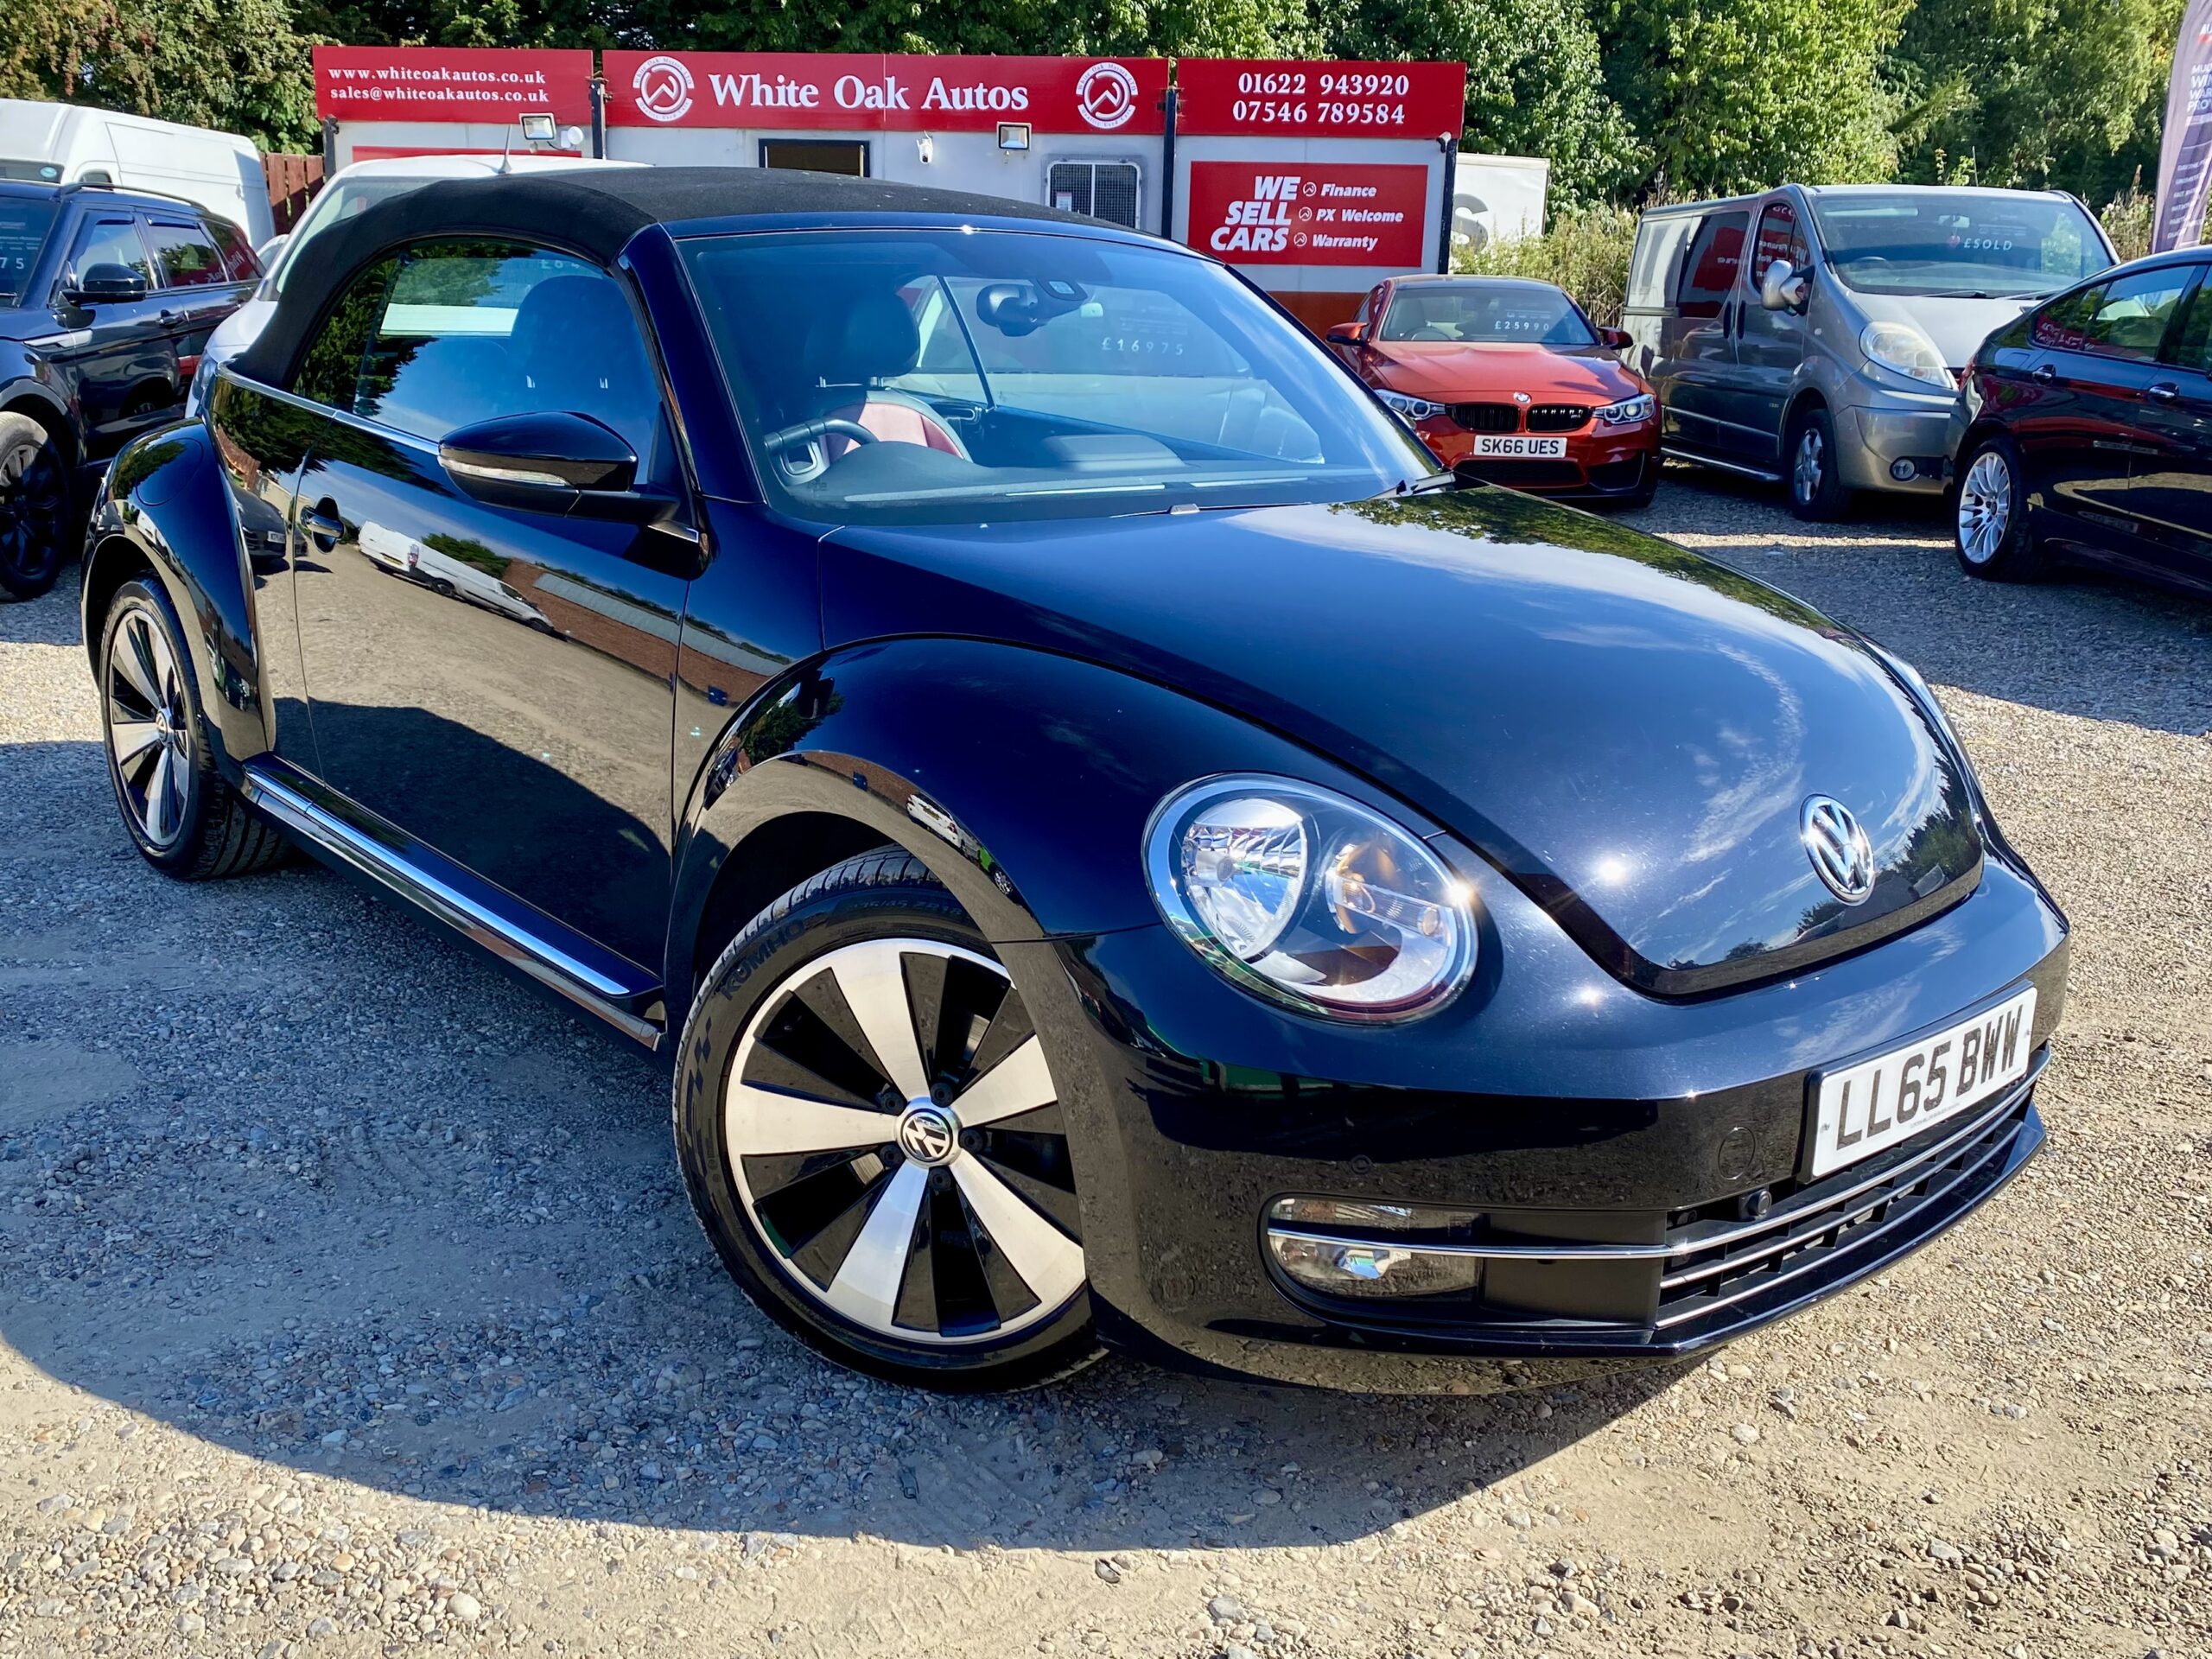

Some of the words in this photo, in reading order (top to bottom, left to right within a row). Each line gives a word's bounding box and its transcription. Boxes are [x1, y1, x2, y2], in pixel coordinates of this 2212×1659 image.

[328, 66, 546, 85] www.whiteoakautos.co.uk
[1238, 73, 1306, 94] 01622
[1319, 74, 1409, 96] 943920
[330, 86, 549, 102] sales@whiteoakautos.co.uk
[708, 73, 819, 107] White
[834, 74, 910, 110] Oak
[920, 77, 1029, 111] Autos
[1232, 100, 1307, 123] 07546
[1318, 102, 1405, 124] 789584
[1254, 175, 1301, 200] WE
[1320, 183, 1377, 198] Finance
[1224, 200, 1293, 226] SELL
[1316, 208, 1337, 222] PX
[1341, 208, 1404, 223] Welcome
[1210, 226, 1290, 251] CARS
[1312, 234, 1379, 251] Warranty
[1963, 238, 2012, 251] £SOLD
[1494, 321, 1549, 331] £25990
[1101, 337, 1183, 355] £16975
[1482, 438, 1523, 454] SK66
[1529, 440, 1559, 454] UES
[721, 918, 805, 1001] KUMHO
[1836, 1040, 1952, 1151] LL65
[1955, 1004, 2023, 1097] BWW
